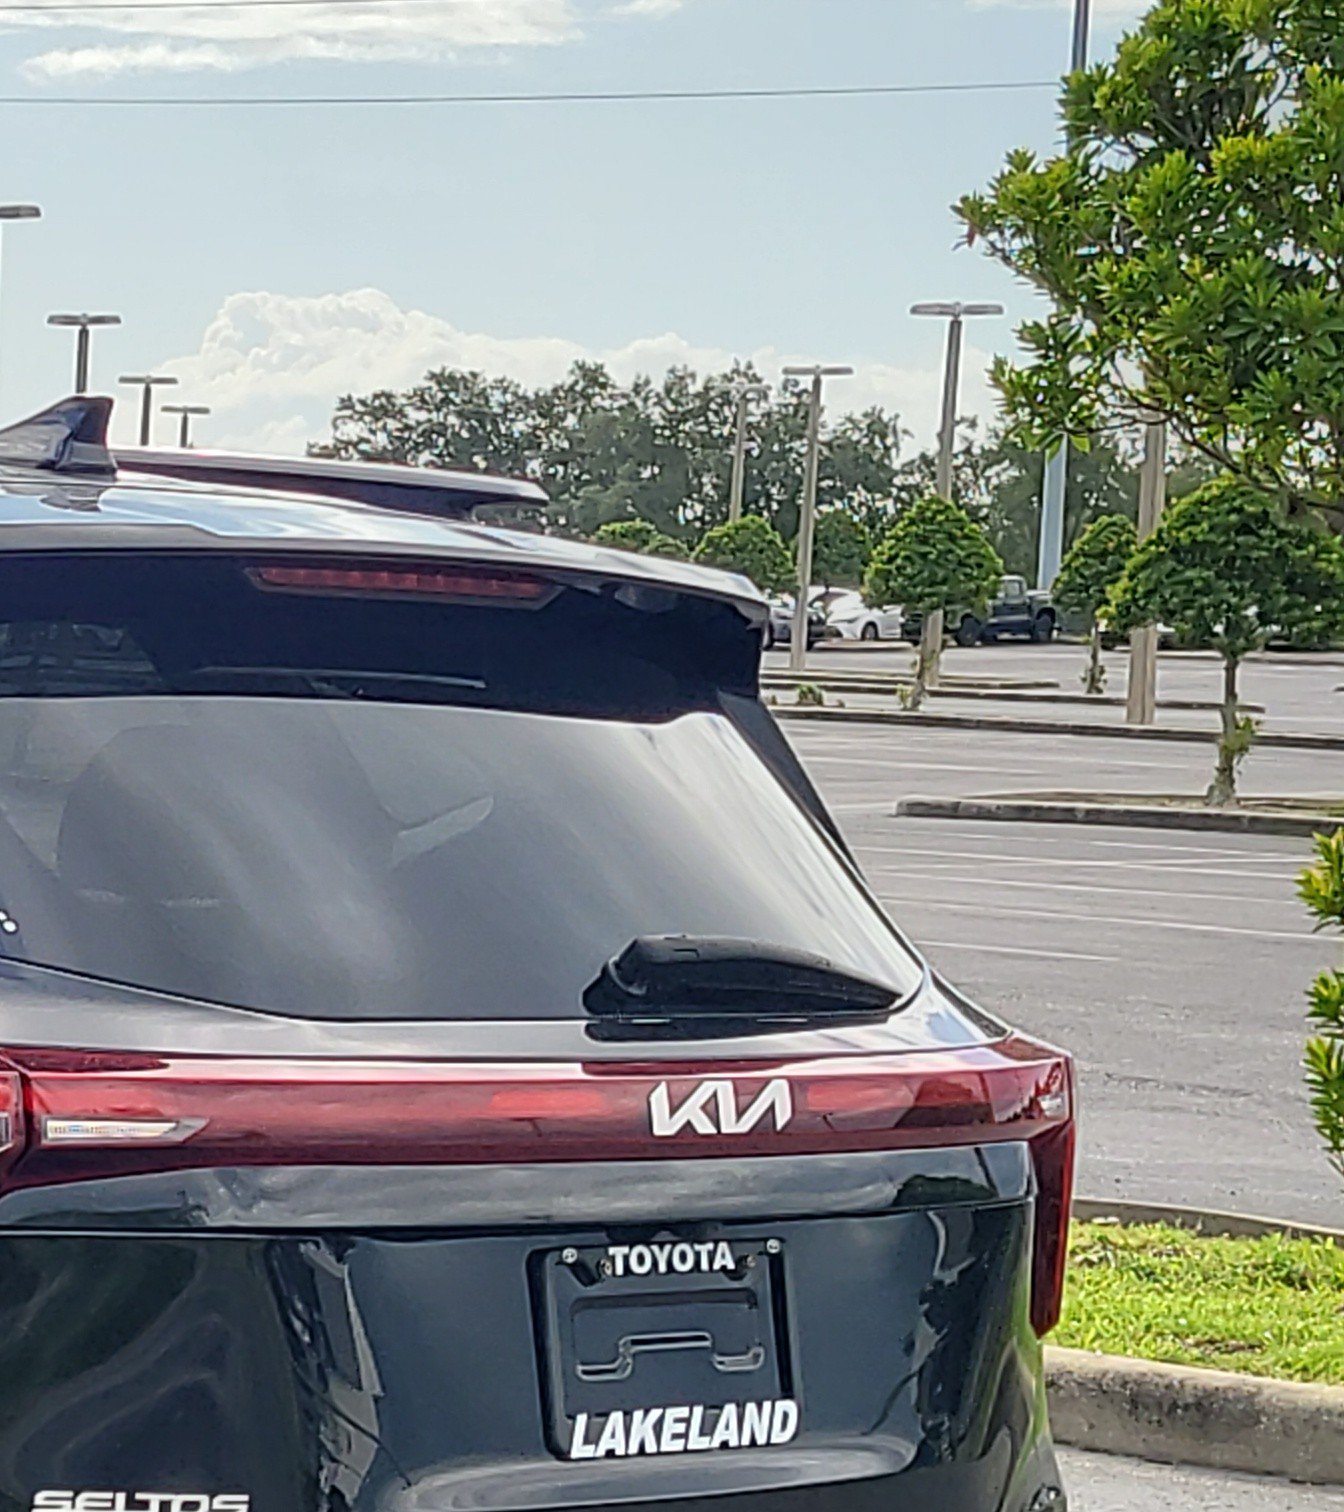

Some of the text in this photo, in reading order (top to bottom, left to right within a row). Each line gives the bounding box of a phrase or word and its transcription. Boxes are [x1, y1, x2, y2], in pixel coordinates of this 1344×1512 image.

[649, 1079, 793, 1136] KIA
[608, 1241, 736, 1276] TOYOTA
[570, 1399, 799, 1460] LAKELAND
